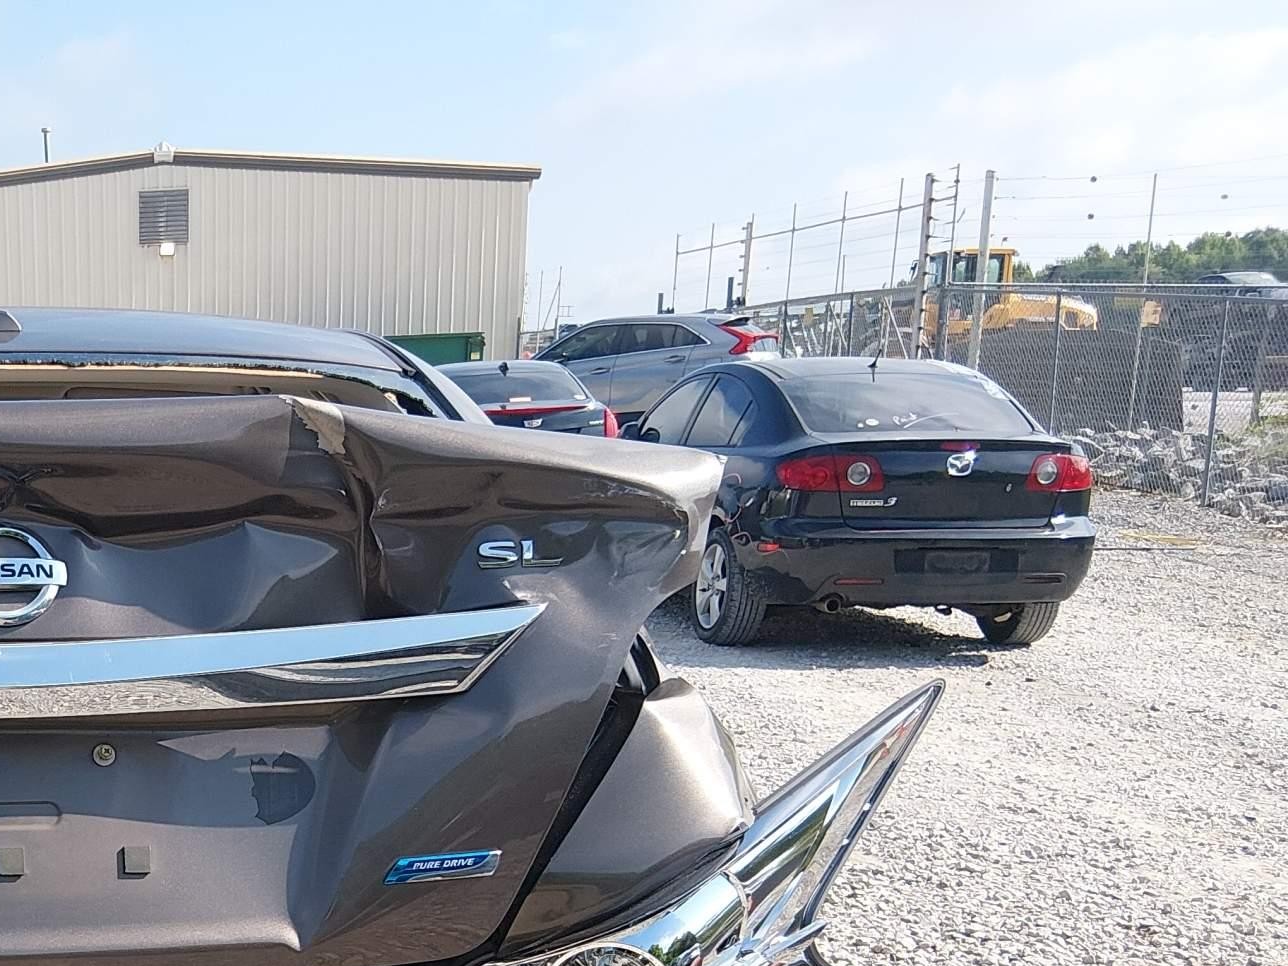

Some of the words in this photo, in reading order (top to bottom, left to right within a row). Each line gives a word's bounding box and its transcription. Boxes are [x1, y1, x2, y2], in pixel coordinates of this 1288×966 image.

[477, 540, 563, 568] SL
[412, 860, 441, 871] PURE
[443, 857, 476, 868] DRIVE
